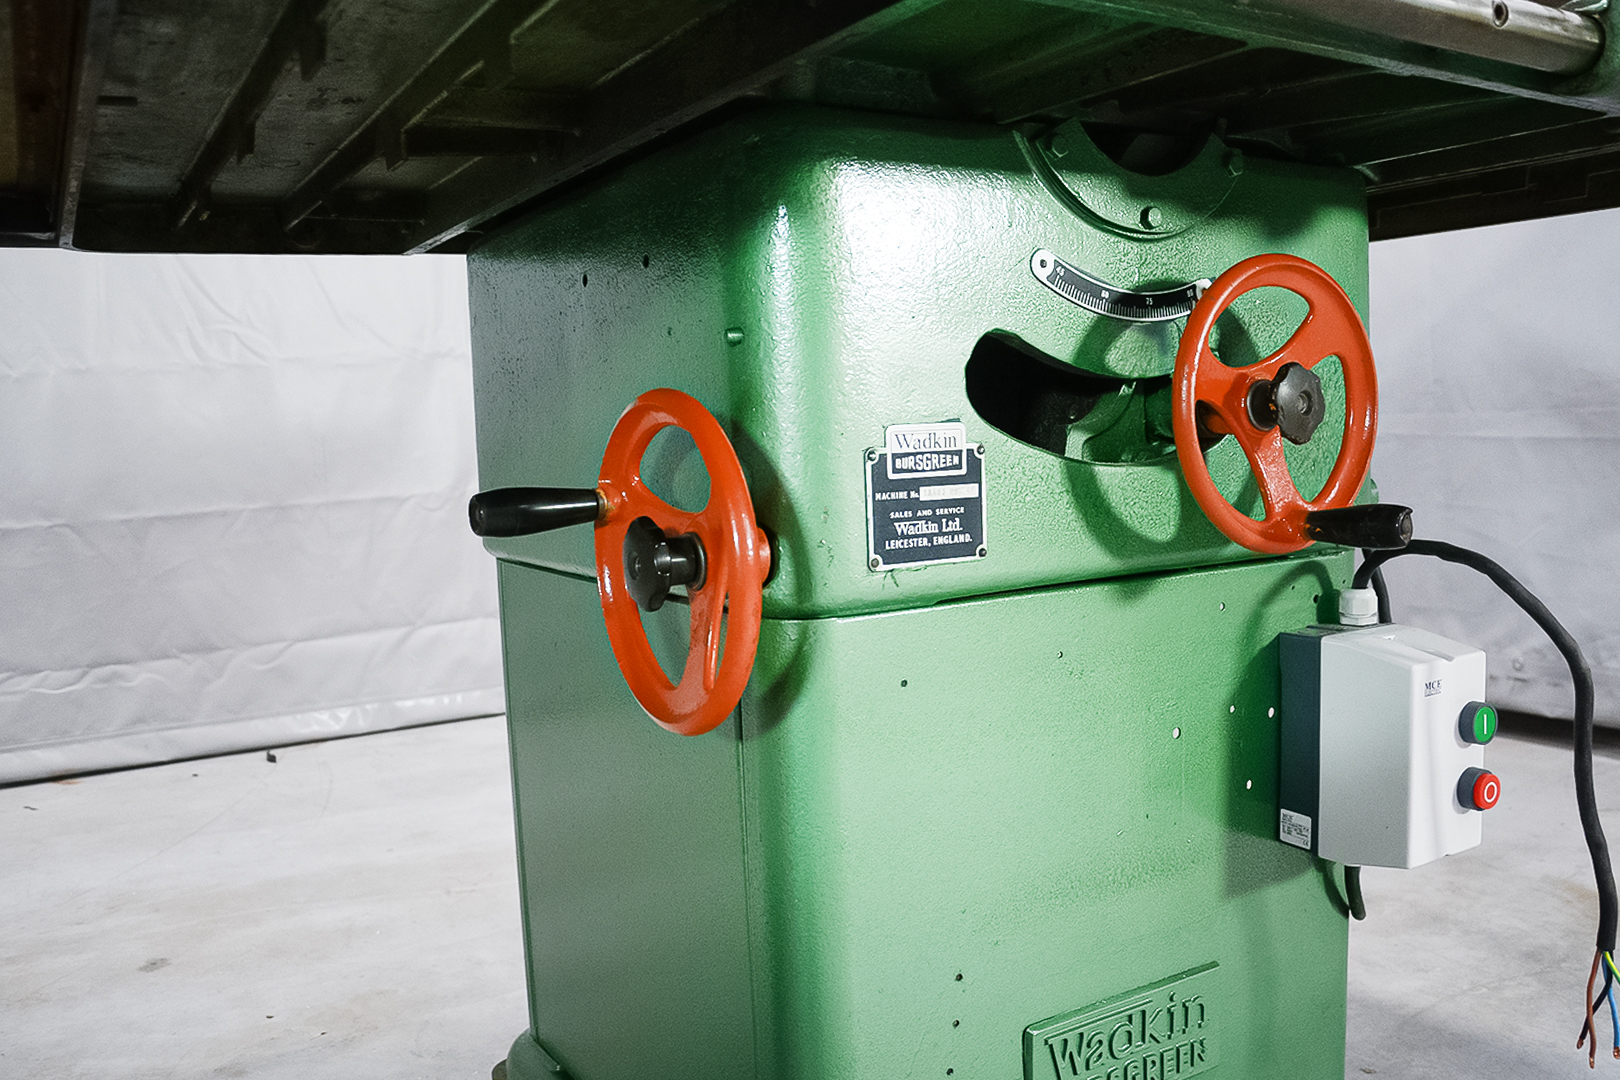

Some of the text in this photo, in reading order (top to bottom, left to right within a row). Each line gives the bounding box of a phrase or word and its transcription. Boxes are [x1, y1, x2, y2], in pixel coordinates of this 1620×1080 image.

[1145, 297, 1154, 306] 75
[894, 431, 958, 451] Wadkin
[895, 453, 960, 471] BURSGREEN
[875, 491, 908, 501] MACHINE
[889, 507, 965, 519] SALES AND SERVICE
[893, 517, 963, 536] Wadkin Ltd.
[885, 533, 973, 551] LEICESTER, ENGLAND.
[1043, 991, 1206, 1080] Wadkin
